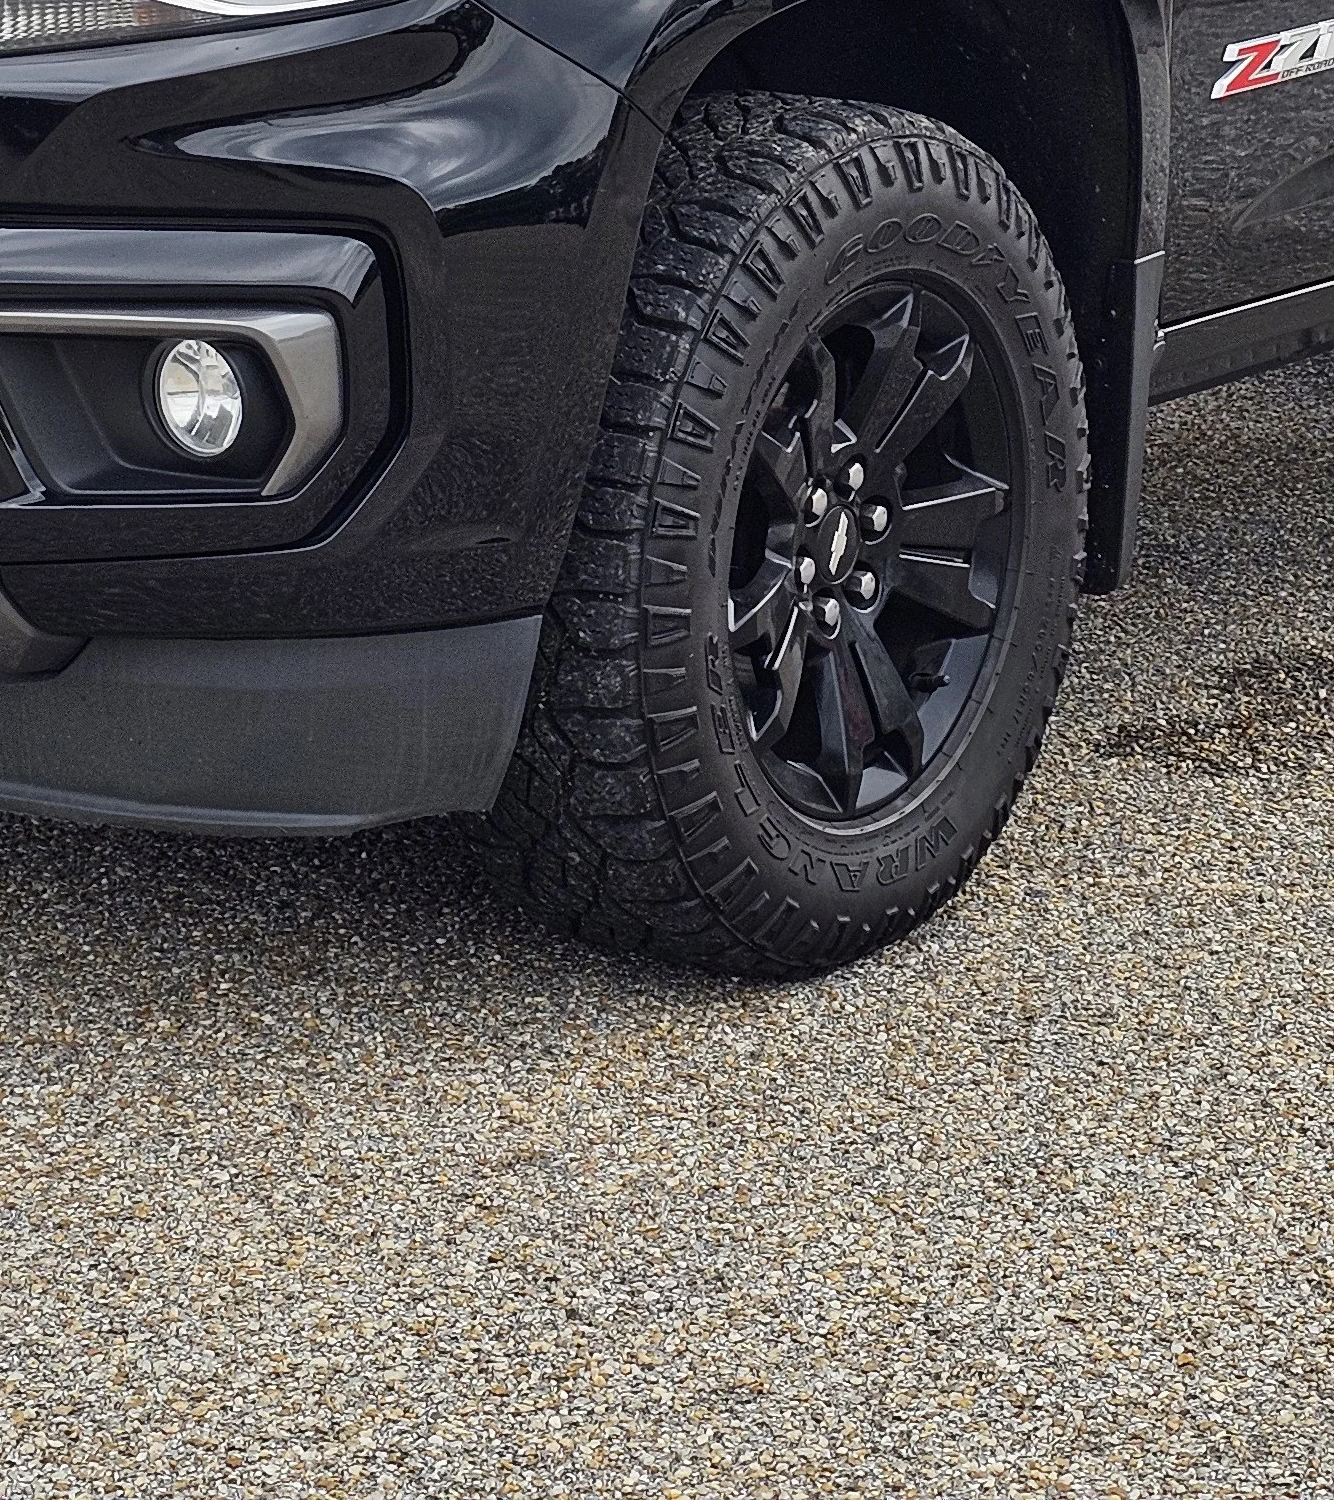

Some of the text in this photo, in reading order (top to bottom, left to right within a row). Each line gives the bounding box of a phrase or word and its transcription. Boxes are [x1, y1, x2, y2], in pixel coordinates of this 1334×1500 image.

[1280, 67, 1304, 80] OFF
[824, 211, 1067, 494] GOODYEAR
[703, 633, 959, 894] WRANGLER
